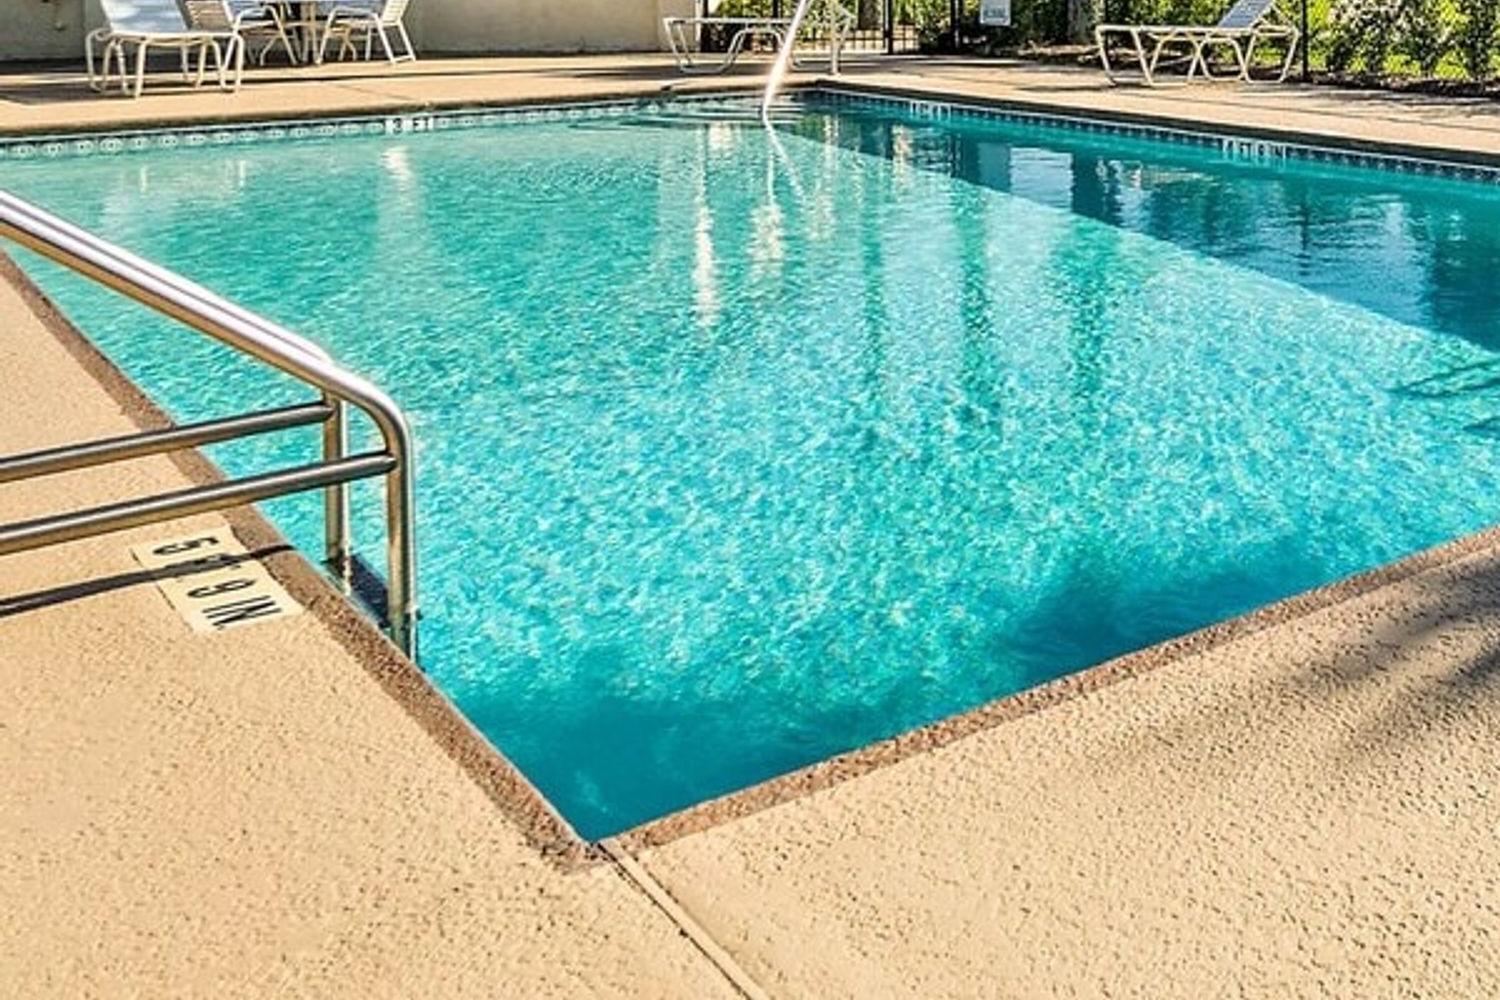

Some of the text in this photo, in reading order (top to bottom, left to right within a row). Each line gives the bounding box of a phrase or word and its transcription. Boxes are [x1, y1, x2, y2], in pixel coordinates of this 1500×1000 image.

[412, 116, 429, 133] FT
[152, 536, 220, 555] 5
[186, 577, 258, 598] 9
